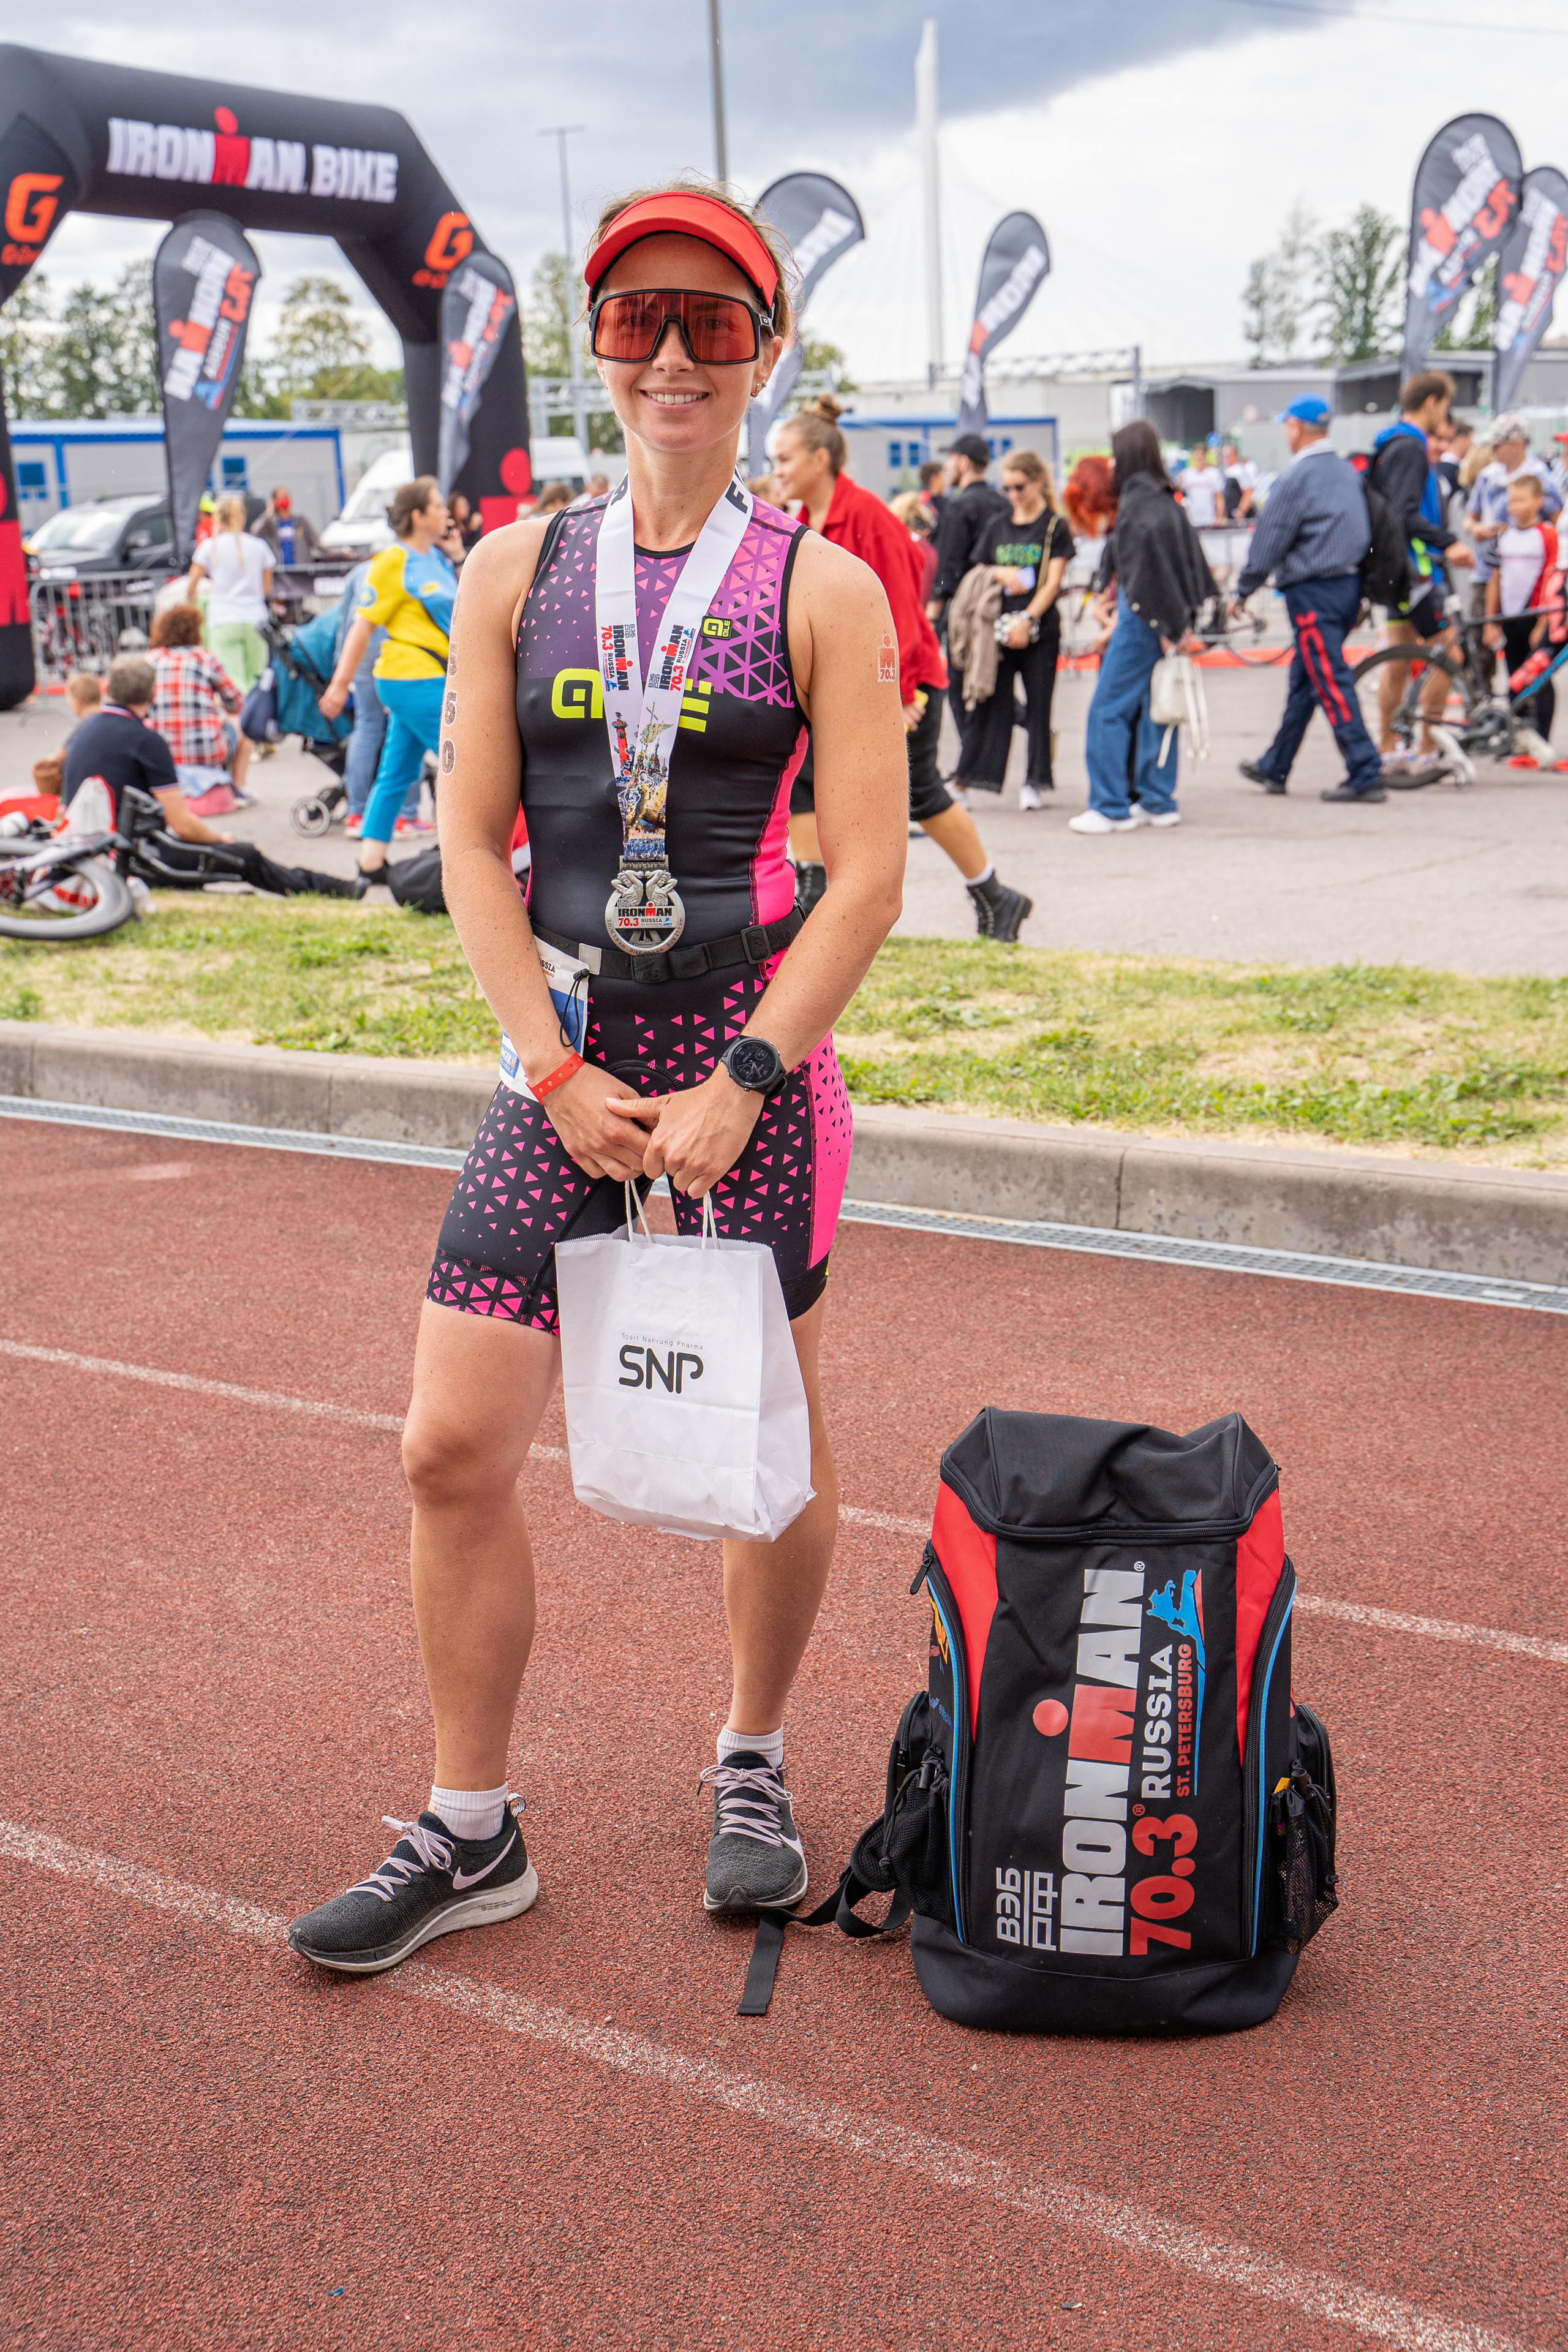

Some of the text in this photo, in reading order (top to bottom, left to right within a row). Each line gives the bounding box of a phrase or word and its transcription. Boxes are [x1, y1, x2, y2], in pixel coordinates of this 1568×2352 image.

[106, 113, 398, 203] IRONMAN BIKE
[601, 625, 614, 650] 70.3
[613, 625, 630, 690] IRONMAN
[659, 624, 684, 690] IRONMAN
[670, 639, 687, 692] 70.3 RUSSIA
[880, 668, 895, 680] 70.3
[618, 907, 672, 917] IRONMAN
[618, 918, 639, 927] 70.3
[666, 937, 676, 947] RUN
[619, 1344, 704, 1394] SNP
[622, 1332, 703, 1350] Sport Nahrung Pharma
[1177, 1644, 1193, 1797] ST. PETERSBURG
[1057, 1569, 1145, 1956] IRONMAN
[1129, 1644, 1198, 1956] 70.3 RUSSIA
[996, 1867, 1021, 1945] ВЭБ
[1032, 1871, 1058, 1951] РФ
